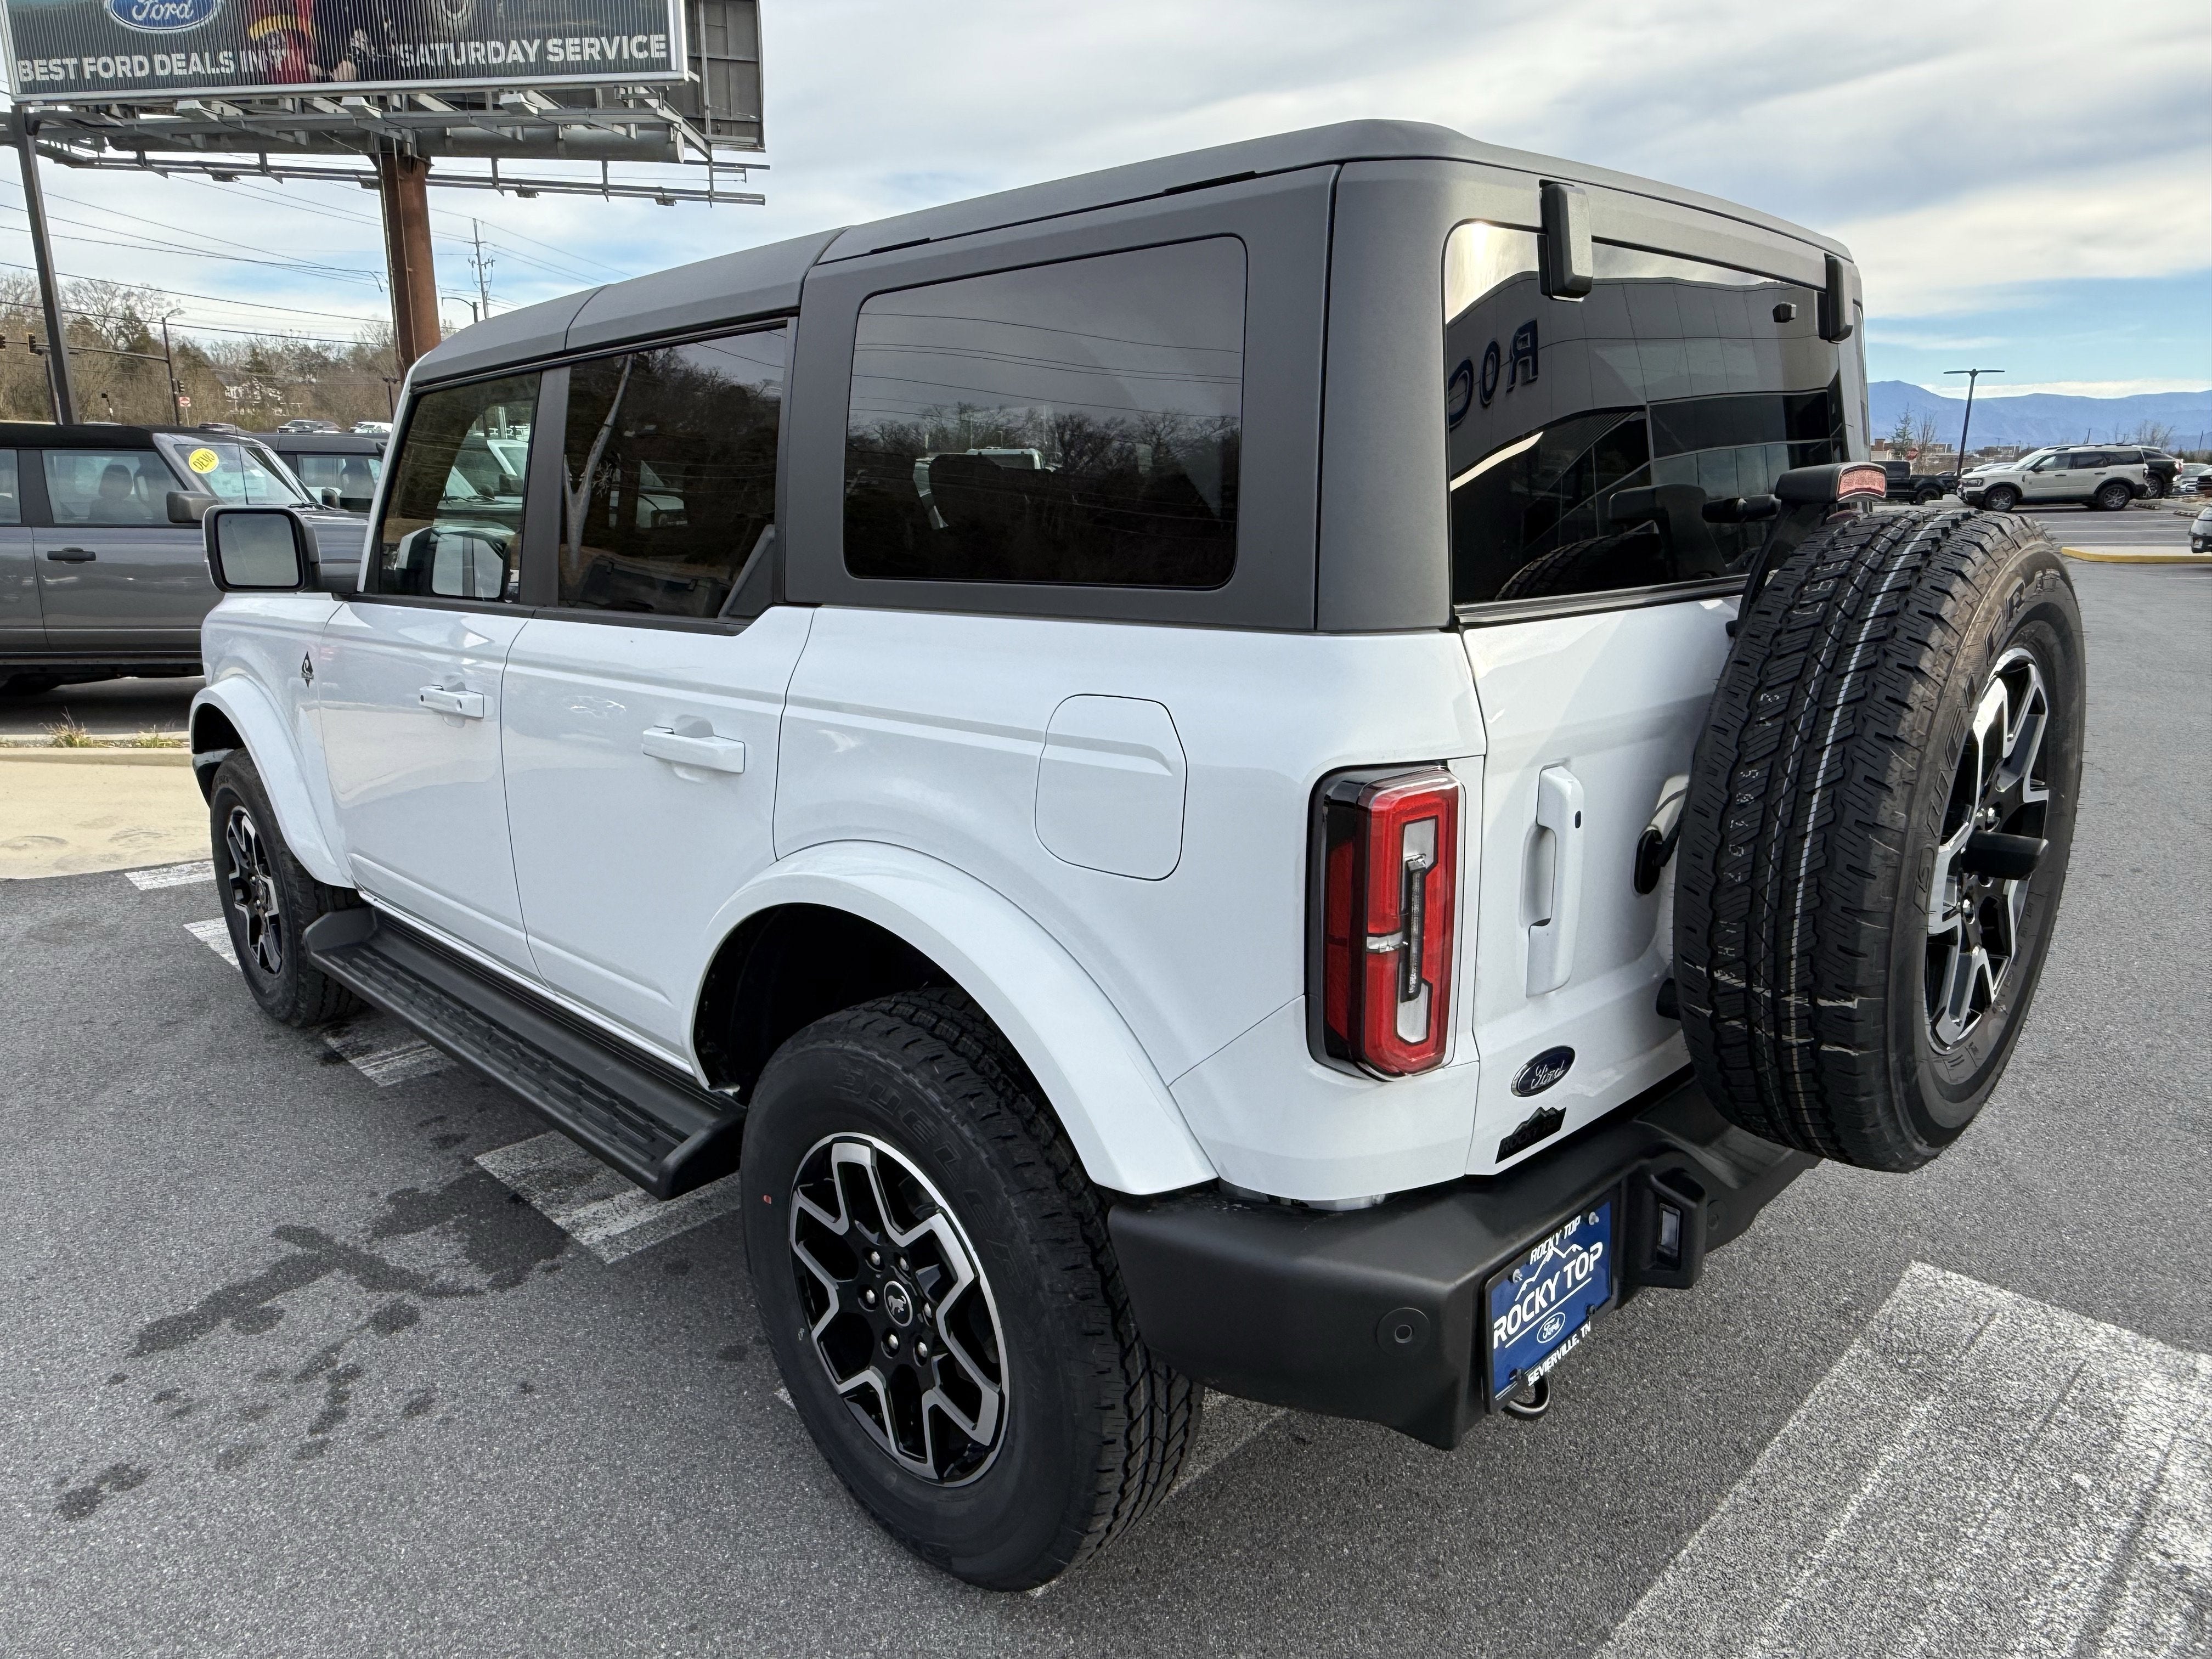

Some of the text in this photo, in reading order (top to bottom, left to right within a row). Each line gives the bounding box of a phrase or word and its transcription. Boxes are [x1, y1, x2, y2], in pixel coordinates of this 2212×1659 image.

[132, 0, 194, 21] Ford
[397, 34, 667, 67] SATURDAY SERVICE
[17, 57, 78, 82] BEST
[82, 54, 149, 80] FORD
[154, 51, 234, 76] DEALS
[1531, 1059, 1565, 1090] Ford
[1530, 1215, 1581, 1265] ROCKY TOP
[1493, 1242, 1603, 1349] ROCKY TOP
[1542, 1318, 1561, 1339] Ford
[1581, 1321, 1591, 1338] TN
